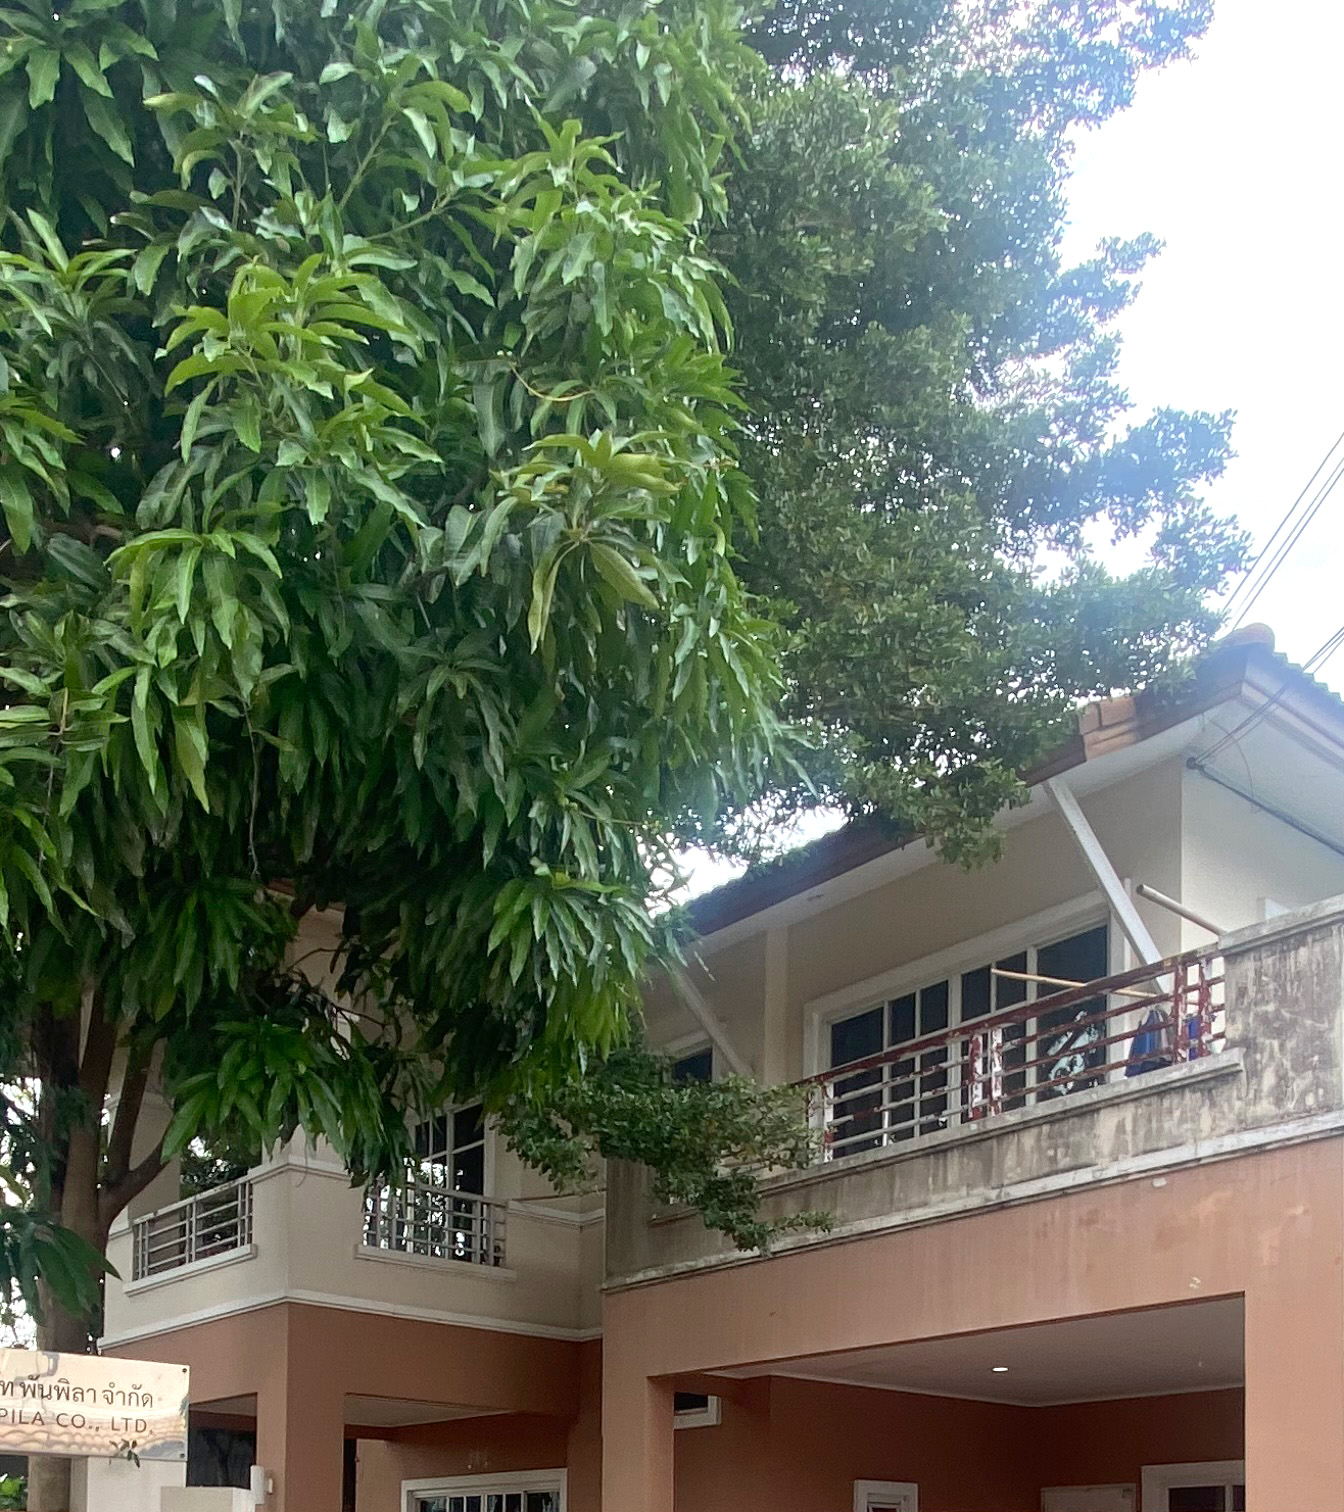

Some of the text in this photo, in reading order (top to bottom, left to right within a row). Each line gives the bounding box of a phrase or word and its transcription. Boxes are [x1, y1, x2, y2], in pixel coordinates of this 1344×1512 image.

[18, 1374, 97, 1405] พันพิลา
[102, 1382, 154, 1409] จำกัด
[55, 1412, 101, 1433] CO.,
[110, 1416, 154, 1436] LTD.
